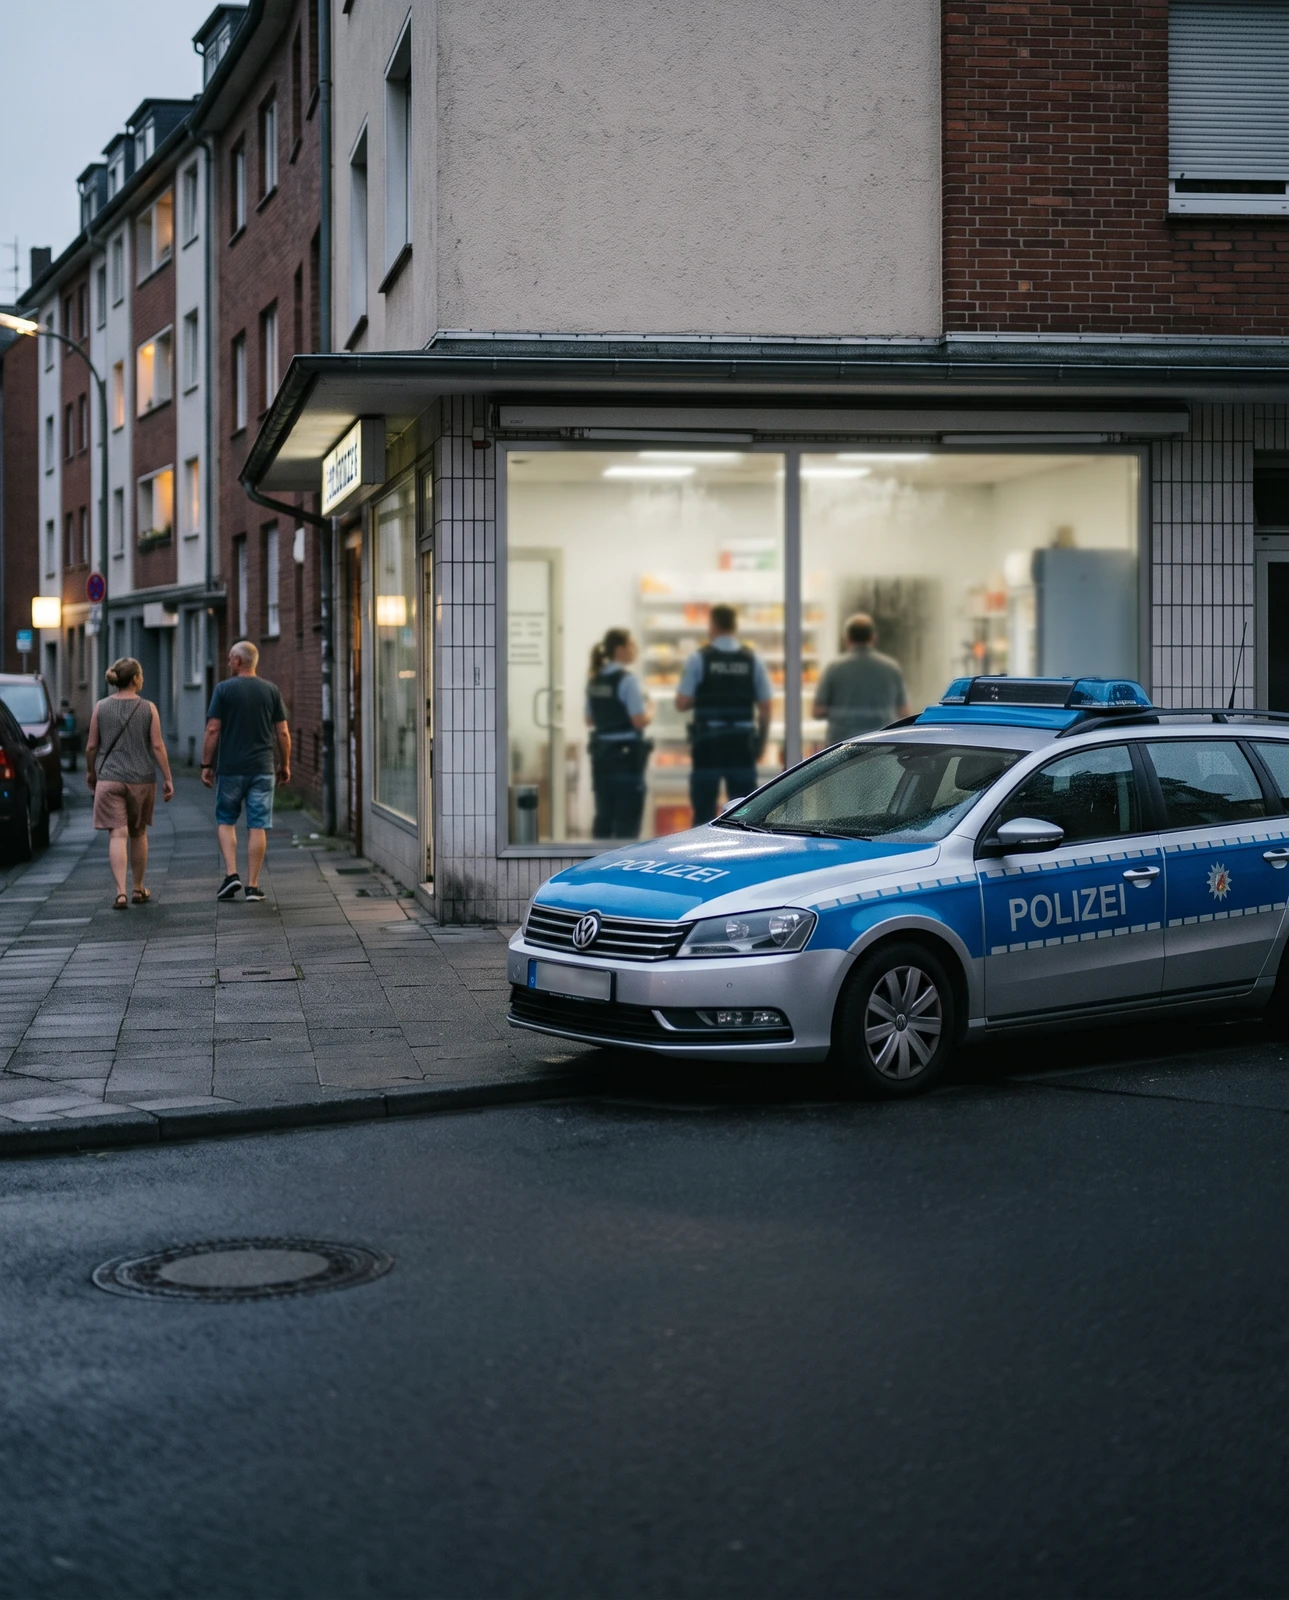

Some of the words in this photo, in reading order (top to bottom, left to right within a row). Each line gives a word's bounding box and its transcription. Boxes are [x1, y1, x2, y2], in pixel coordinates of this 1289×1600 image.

[599, 859, 731, 883] POLIZEI
[1008, 883, 1126, 932] POLIZEI
[572, 915, 598, 948] VW
